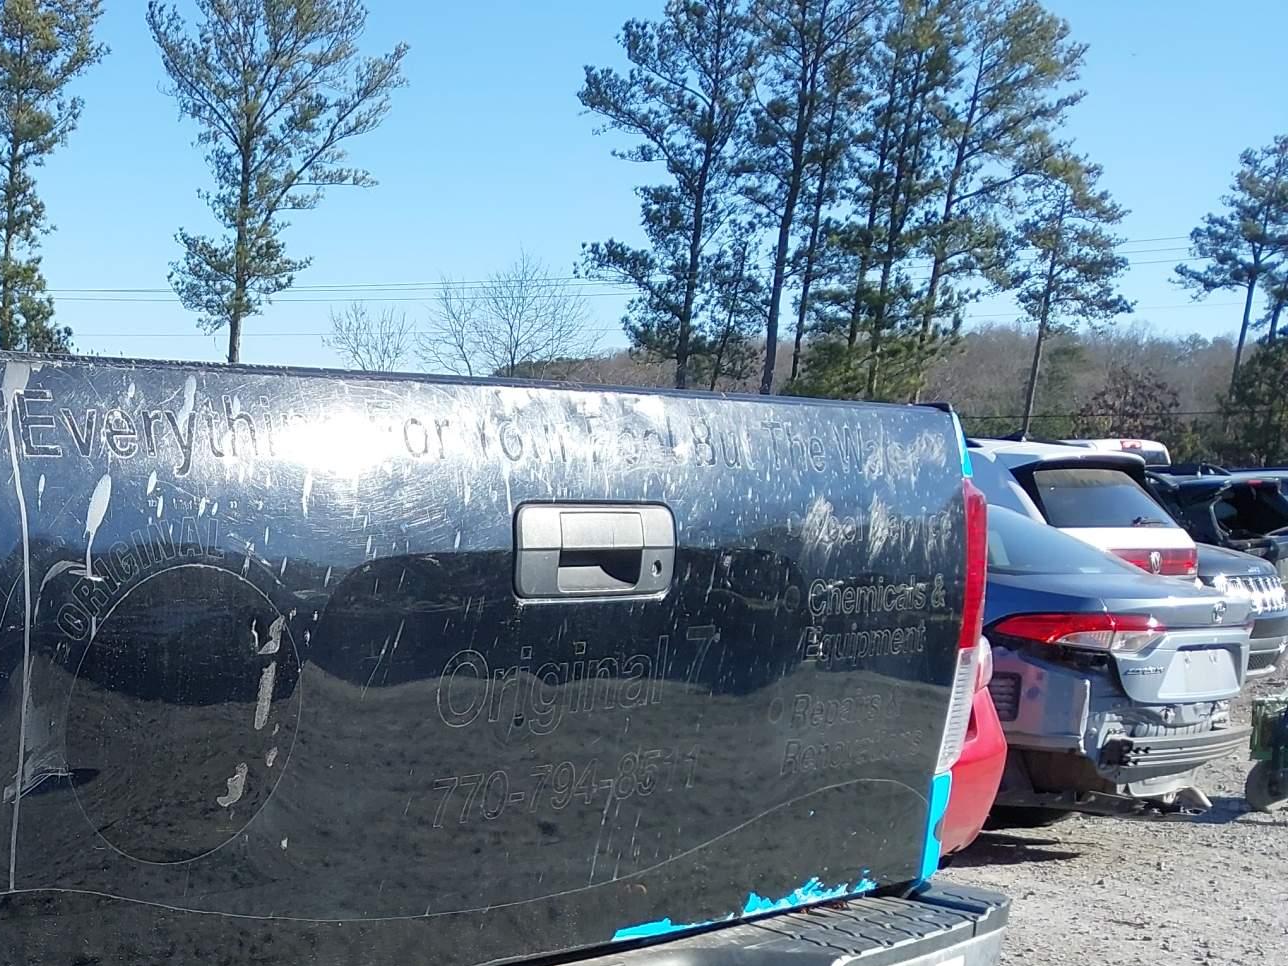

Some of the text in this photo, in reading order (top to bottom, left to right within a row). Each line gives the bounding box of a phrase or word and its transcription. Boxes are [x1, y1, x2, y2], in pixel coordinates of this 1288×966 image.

[760, 420, 828, 474] The
[868, 498, 953, 547] ervice
[56, 516, 225, 640] ORIGINAL
[808, 572, 946, 617] Chemicals &
[801, 620, 926, 669] Equipment
[437, 624, 721, 736] Original 7
